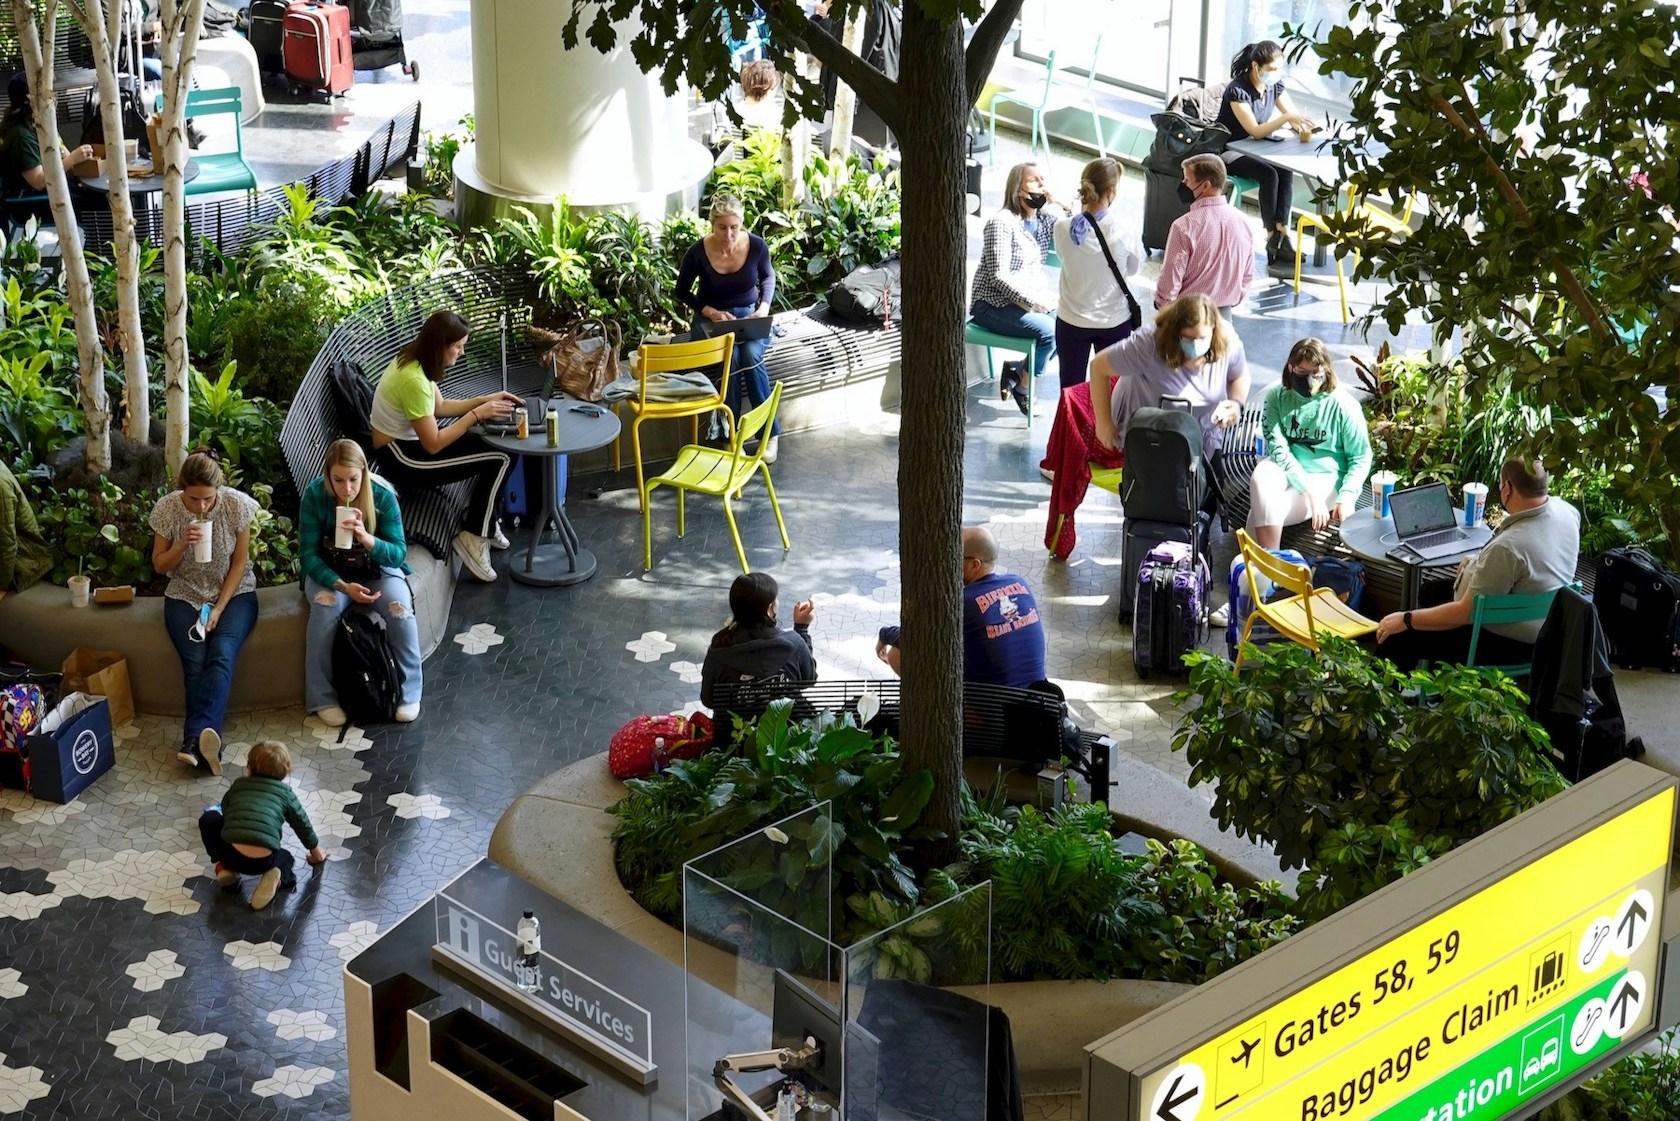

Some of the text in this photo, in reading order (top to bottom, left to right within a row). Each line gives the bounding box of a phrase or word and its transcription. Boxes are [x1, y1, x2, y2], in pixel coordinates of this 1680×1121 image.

[1314, 427, 1327, 441] UP
[549, 975, 634, 1043] Services
[1274, 930, 1460, 1057] Gates 58, 59
[1301, 984, 1519, 1121] Baggage Claim
[1419, 1065, 1513, 1121] tation
